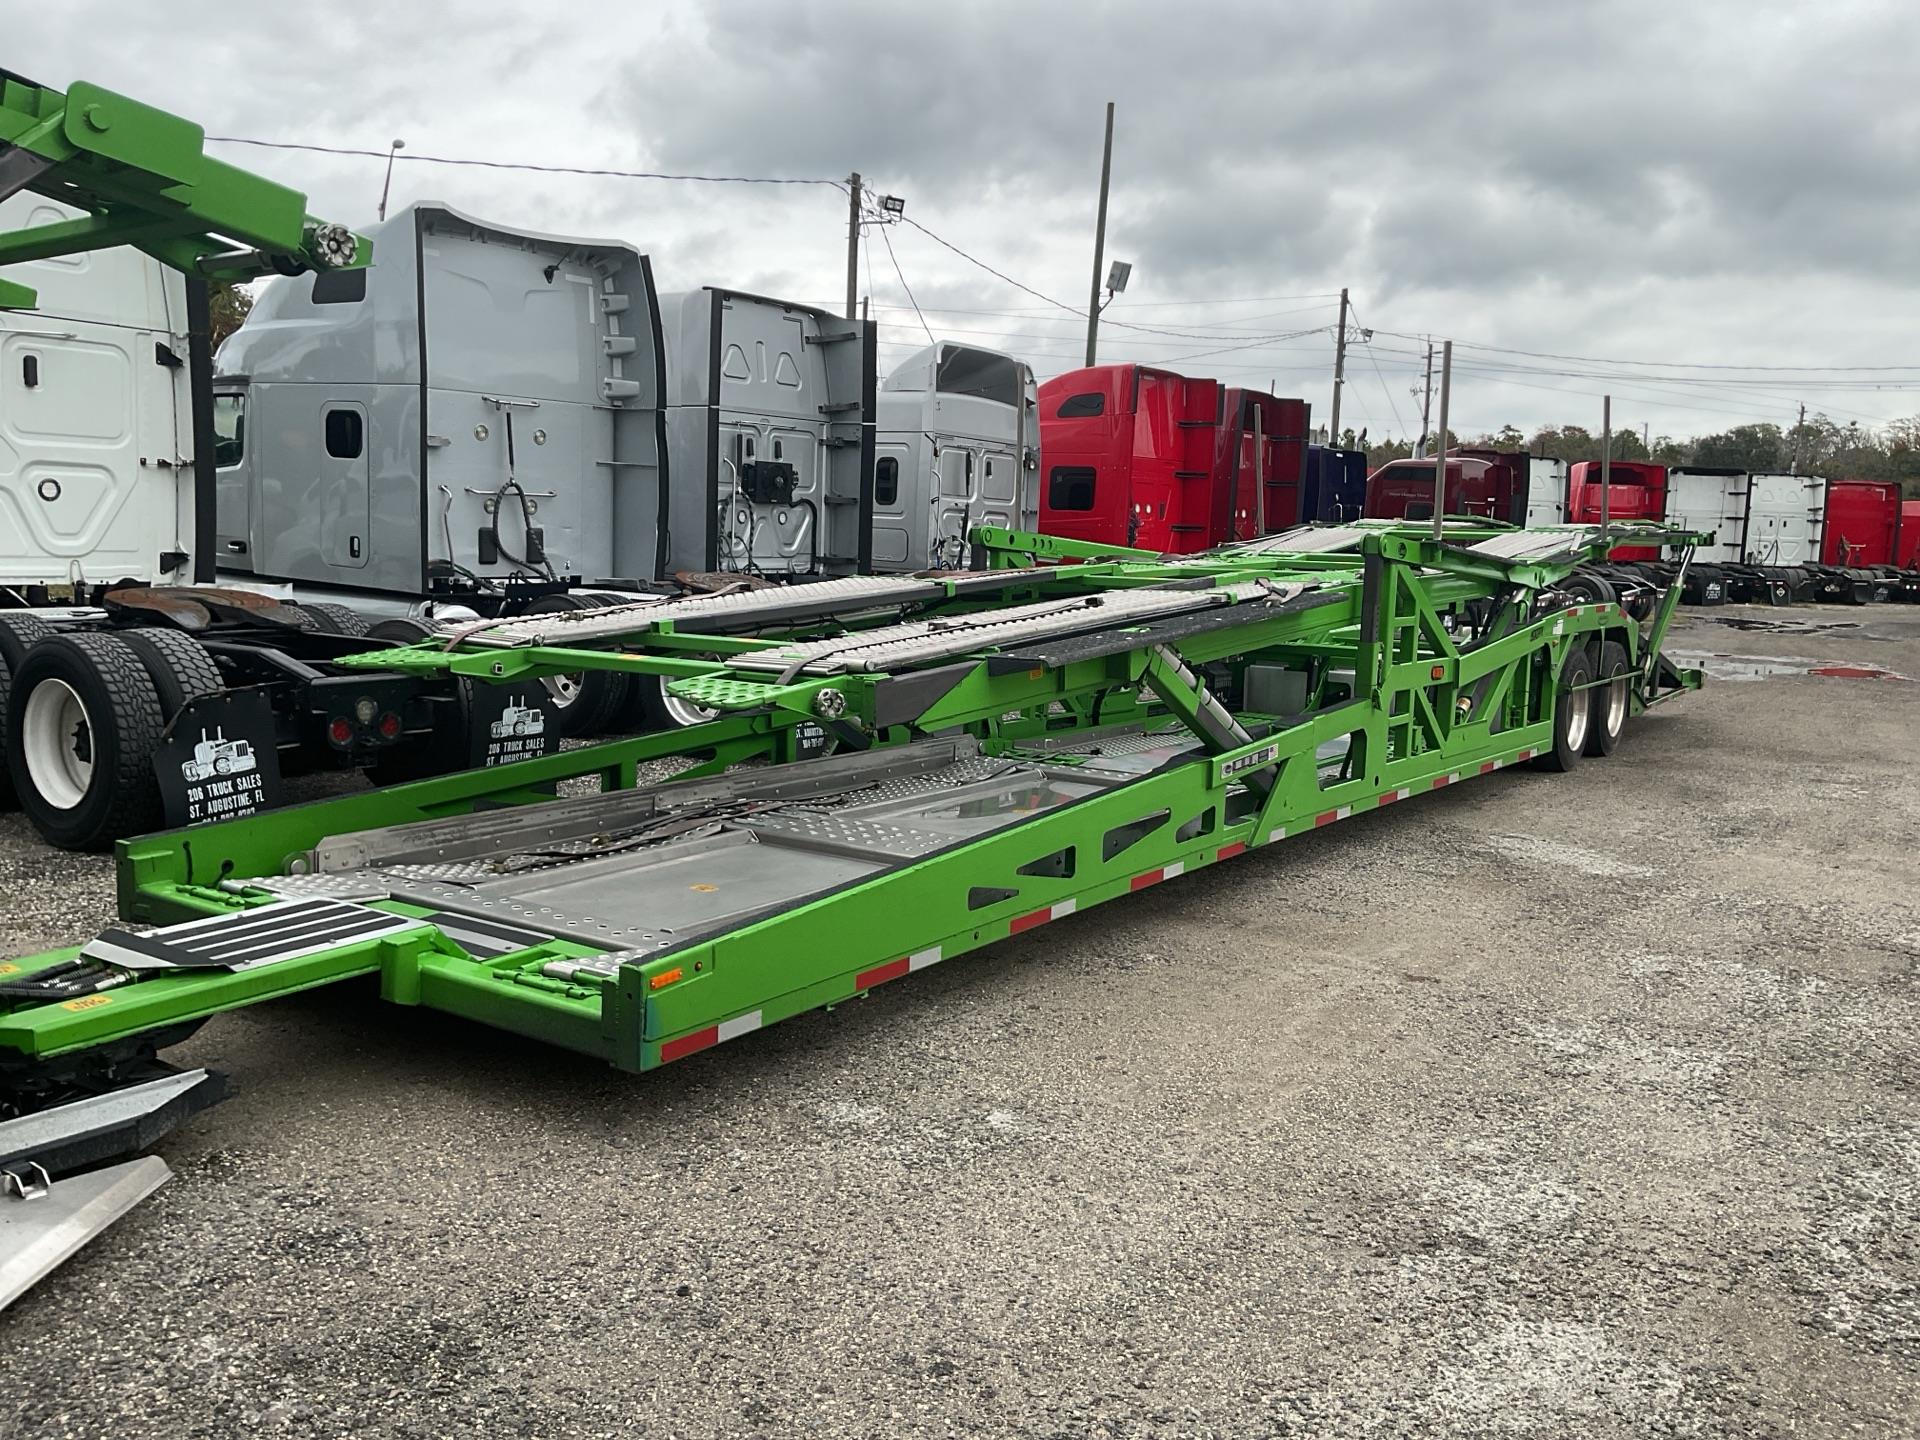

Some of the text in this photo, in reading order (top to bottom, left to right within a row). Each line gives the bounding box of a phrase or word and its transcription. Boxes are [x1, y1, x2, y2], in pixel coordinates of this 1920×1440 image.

[504, 741, 523, 752] TRUCK
[526, 738, 544, 750] SALES
[188, 774, 262, 802] 206 TRUCK SALES
[190, 804, 204, 818] ST.
[208, 792, 252, 814] AUGUSTINE,
[255, 790, 264, 802] FL
